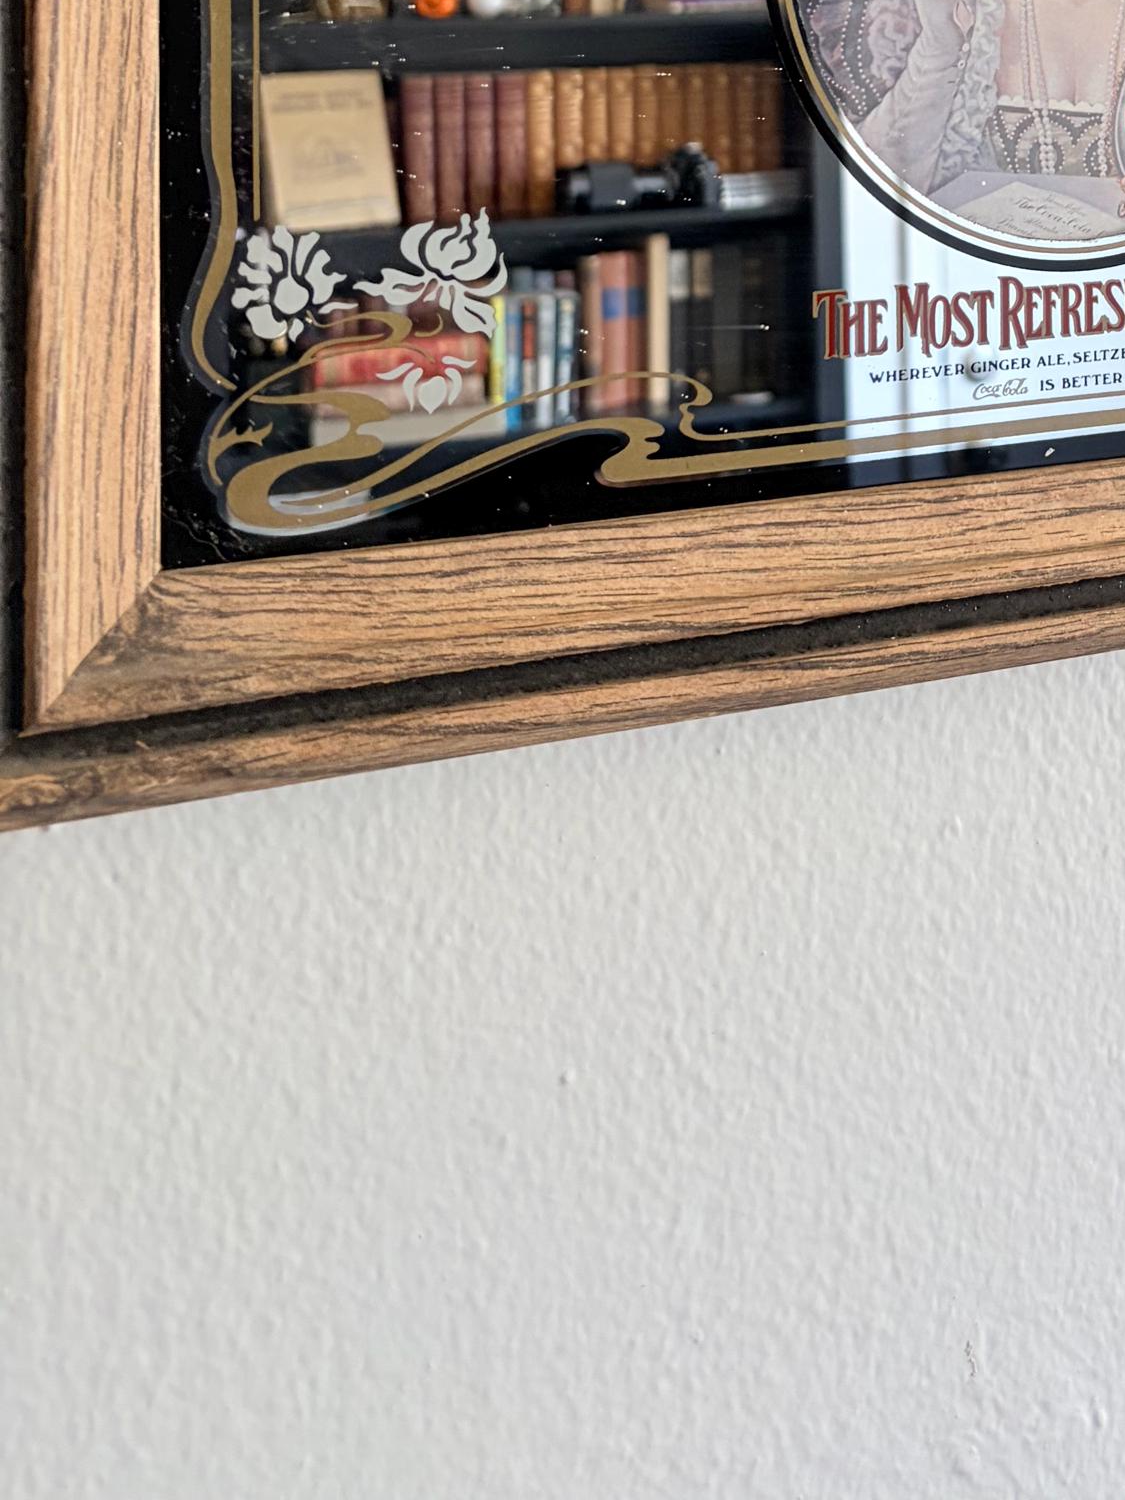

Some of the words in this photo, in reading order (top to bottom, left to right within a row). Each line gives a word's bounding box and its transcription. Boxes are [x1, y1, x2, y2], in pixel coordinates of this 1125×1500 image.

[812, 289, 888, 360] THE
[894, 282, 995, 358] MOST
[869, 364, 965, 383] WHEREVER
[971, 357, 1031, 374] GINGER
[1036, 353, 1070, 368] ALE,
[1040, 379, 1055, 392] IS
[1062, 372, 1122, 389] BETTER
